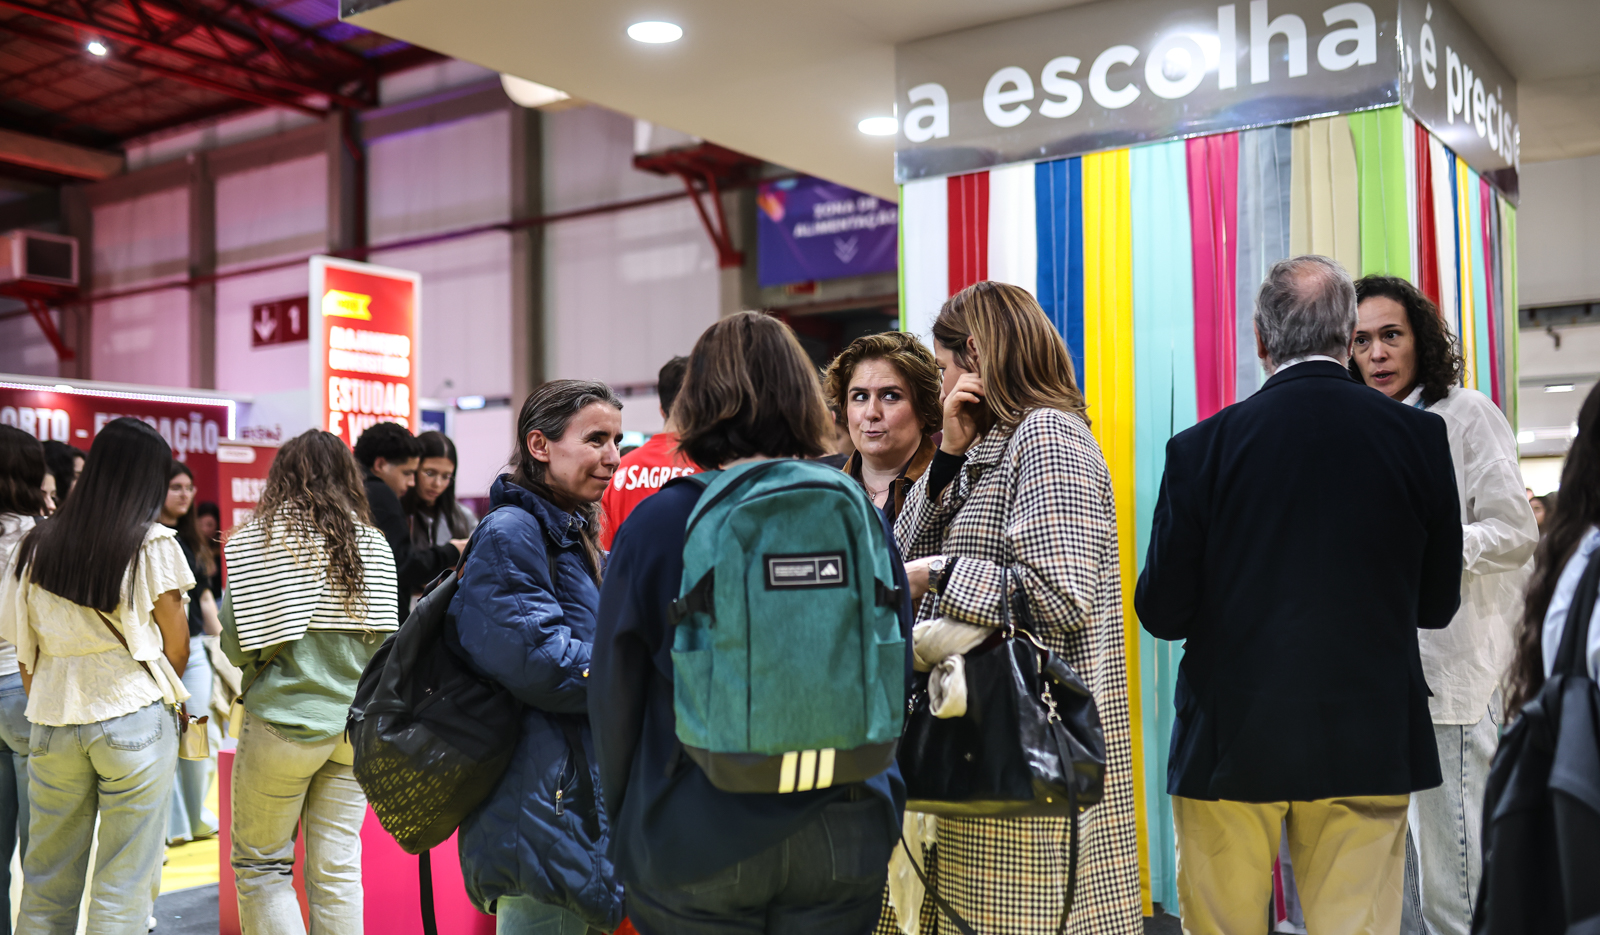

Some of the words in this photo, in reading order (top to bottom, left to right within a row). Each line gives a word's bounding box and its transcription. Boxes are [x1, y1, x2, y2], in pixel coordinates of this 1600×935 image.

[903, 83, 949, 143] a
[982, 0, 1378, 128] escolha
[1420, 2, 1437, 91] é
[287, 305, 301, 335] 1
[328, 376, 411, 417] ESTUDAR
[94, 411, 219, 463] EAÇÃO
